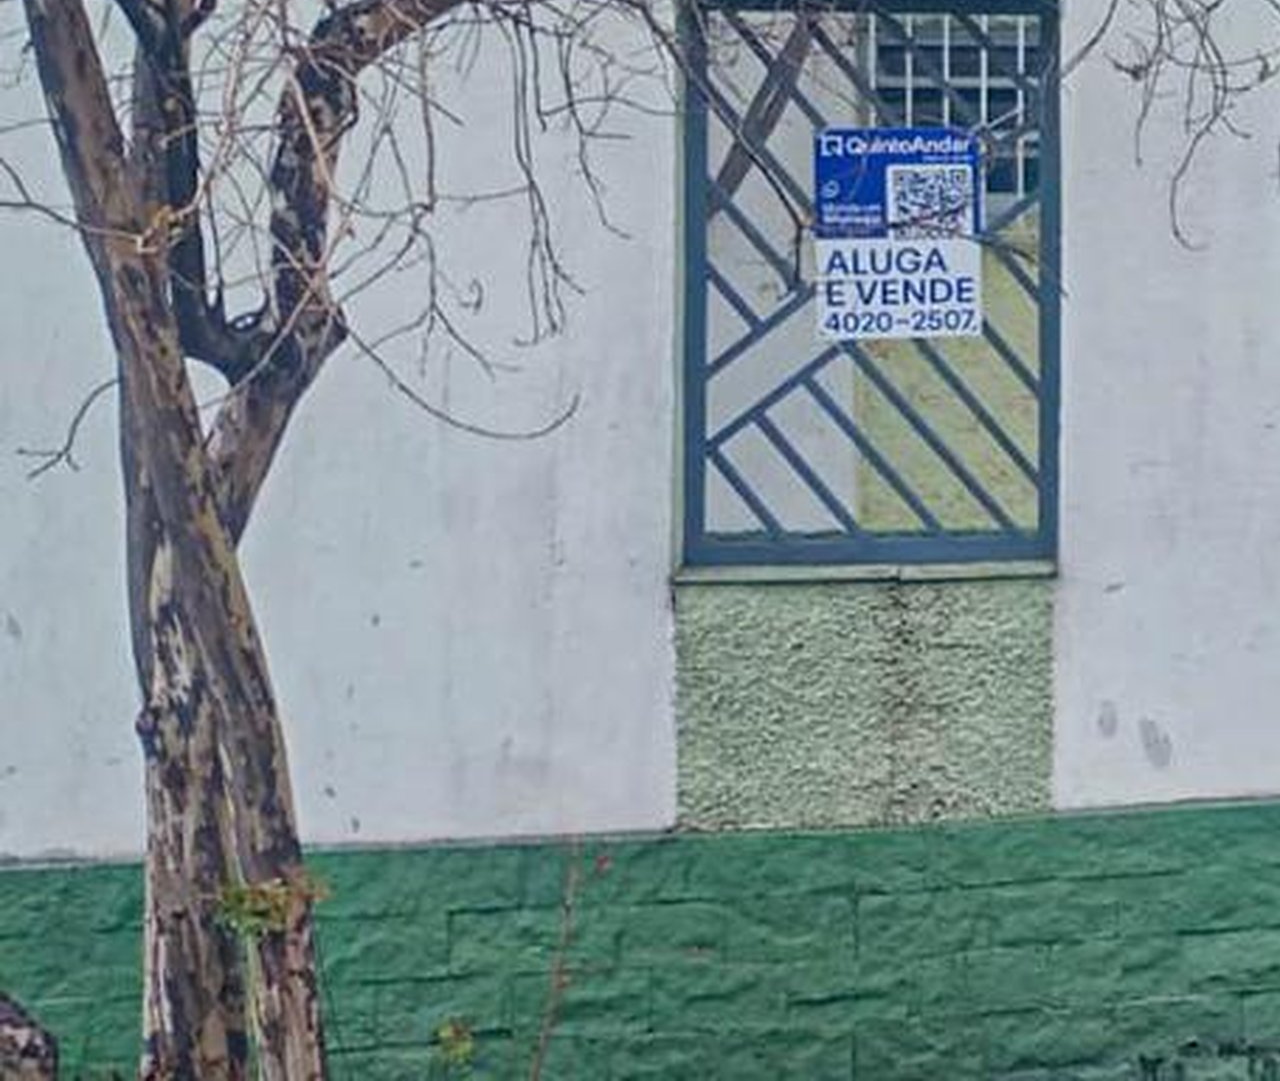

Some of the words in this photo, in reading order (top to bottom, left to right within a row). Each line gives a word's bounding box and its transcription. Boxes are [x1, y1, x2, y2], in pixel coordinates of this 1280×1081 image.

[827, 248, 947, 274] ALUGA
[827, 280, 846, 306] E
[856, 277, 974, 305] VENDE
[824, 310, 974, 332] 4020-2507
